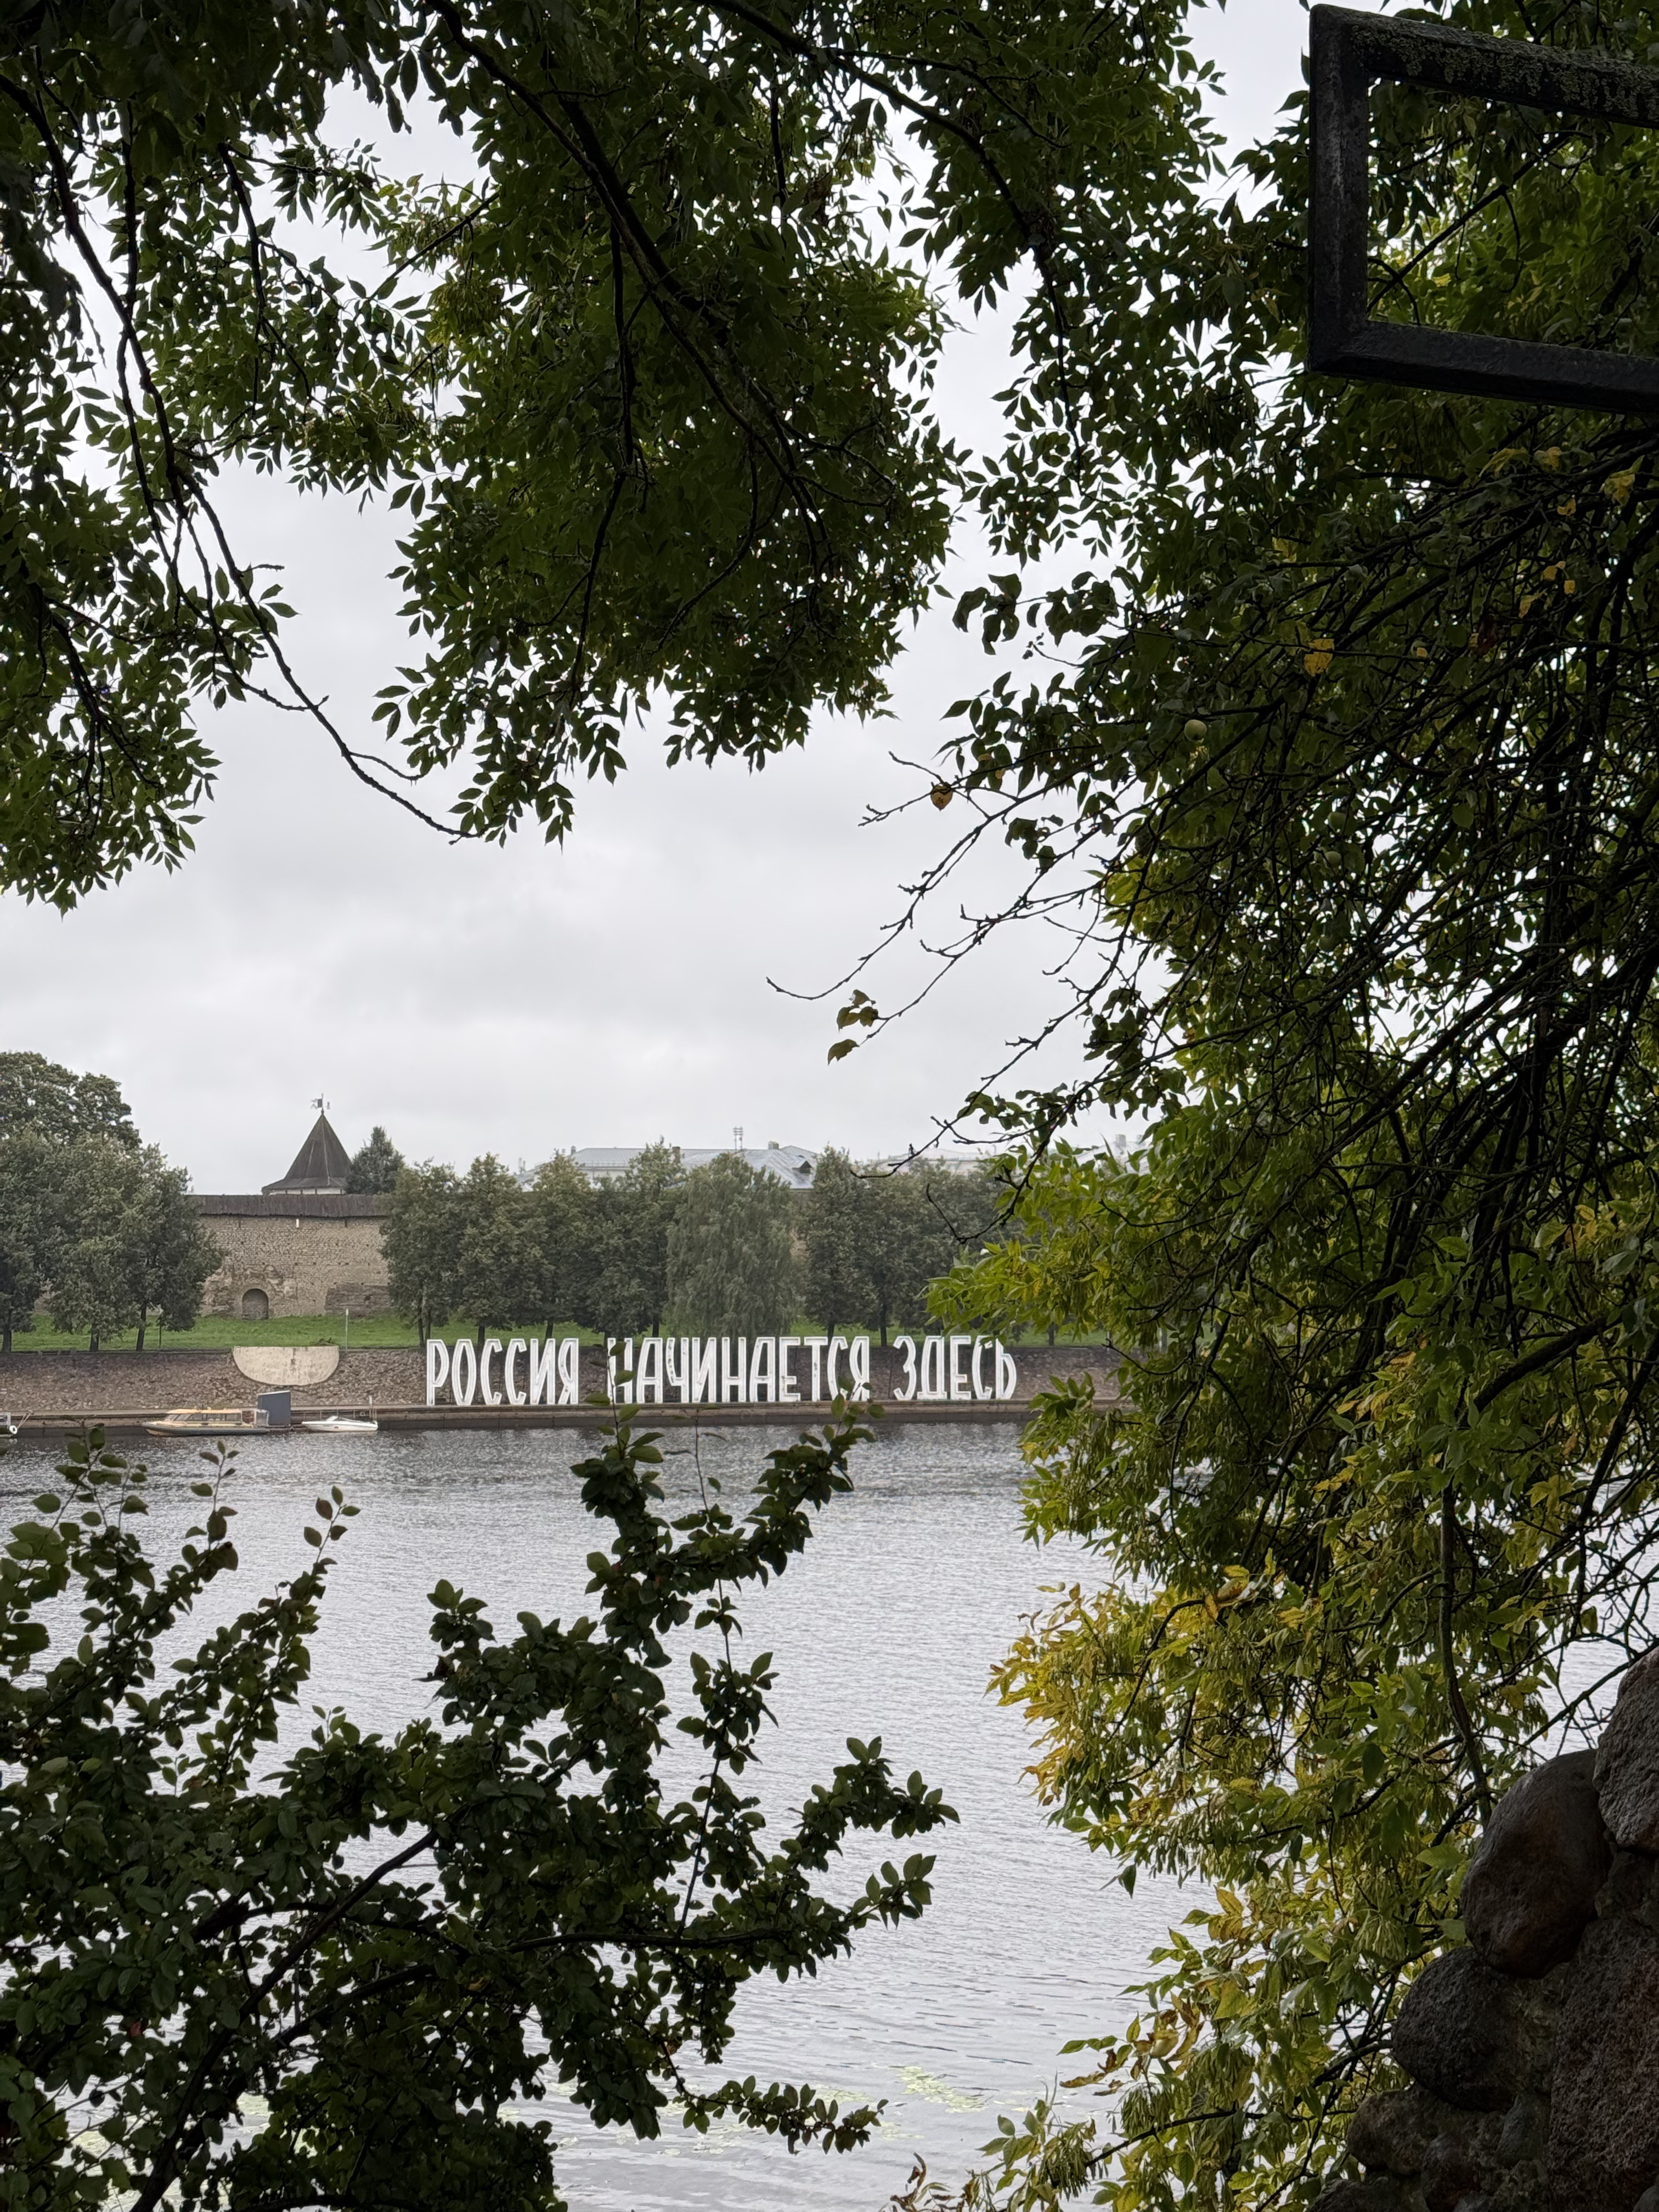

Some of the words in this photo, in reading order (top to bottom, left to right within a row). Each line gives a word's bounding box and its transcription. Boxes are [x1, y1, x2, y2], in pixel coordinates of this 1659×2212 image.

[426, 1338, 579, 1406] РОССИЯ
[607, 1336, 870, 1404] НАЧИНАЕТСЯ
[893, 1335, 1017, 1401] ЗДЕСЬ
